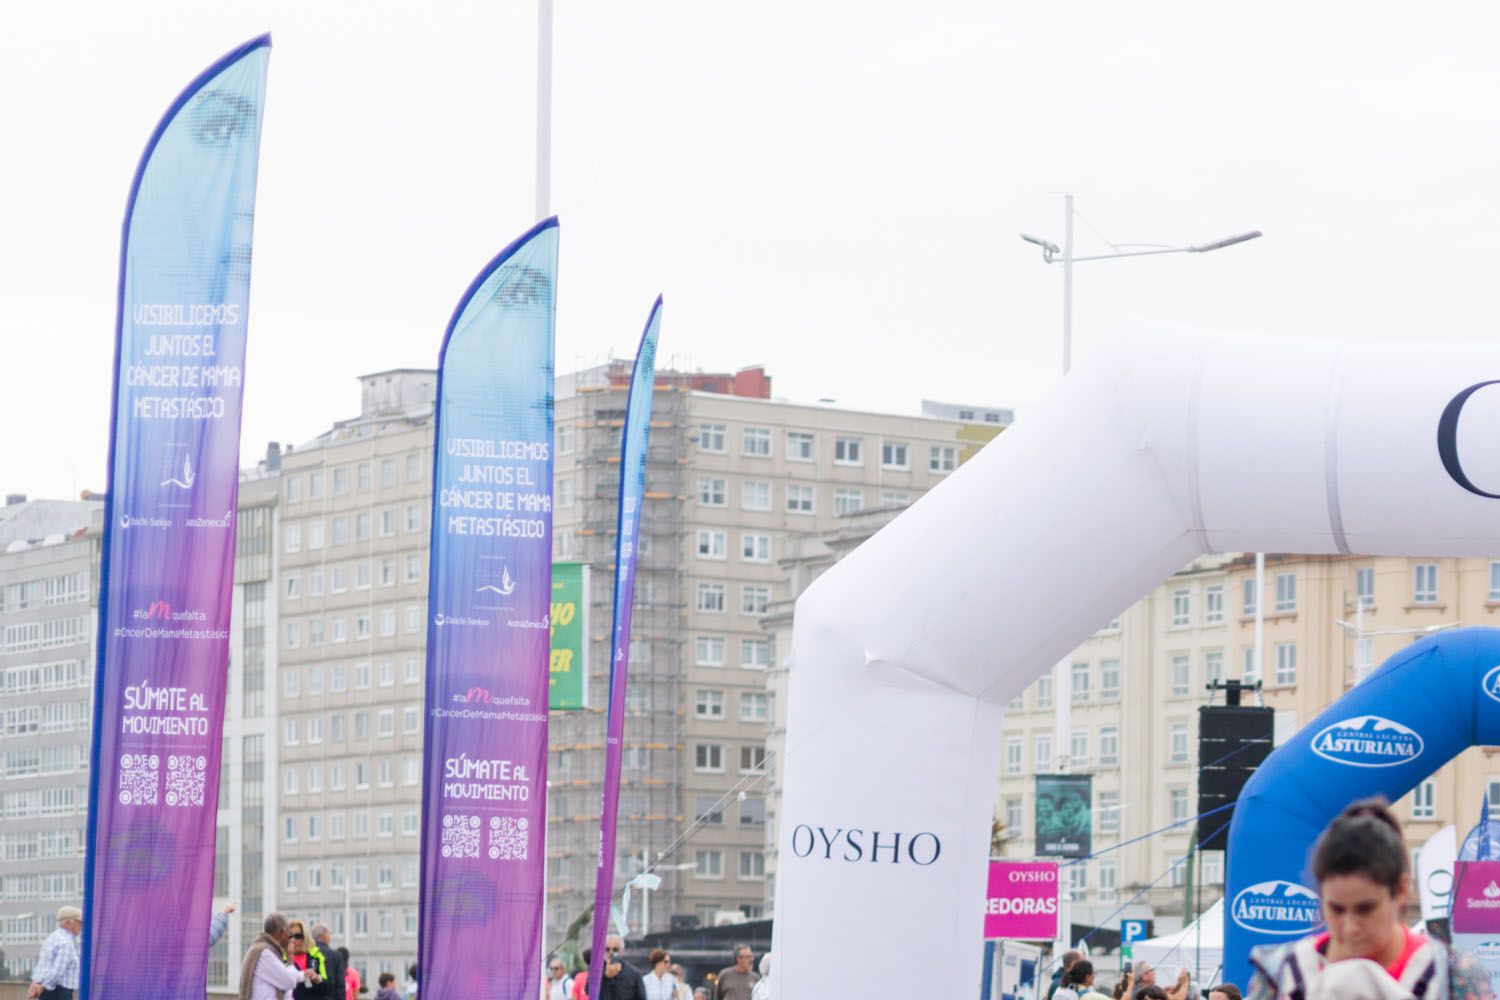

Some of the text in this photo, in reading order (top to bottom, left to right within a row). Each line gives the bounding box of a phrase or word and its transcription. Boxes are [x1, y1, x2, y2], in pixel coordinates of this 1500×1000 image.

[132, 304, 240, 326] VISIBILICEMOS
[144, 335, 216, 357] JUNTOS EL
[127, 361, 241, 388] CÁNCER DE MAMA
[134, 391, 225, 419] METASTÁSICO
[447, 438, 549, 461] VISIBILICEMOS
[458, 464, 534, 486] JUNTOS EL
[440, 484, 551, 512] CÁNCER DE MAMA
[448, 513, 545, 538] METASTÁSICO
[124, 680, 208, 711] SÚMATE AL
[122, 716, 208, 736] MOVIMIENTO
[1319, 733, 1415, 756] ASTURIANA
[445, 753, 530, 781] SÚMATE AL
[444, 782, 529, 801] MOVIMIENTO
[793, 824, 941, 866] OYSHO
[1008, 870, 1056, 883] OYSHO
[1126, 922, 1142, 942] P
